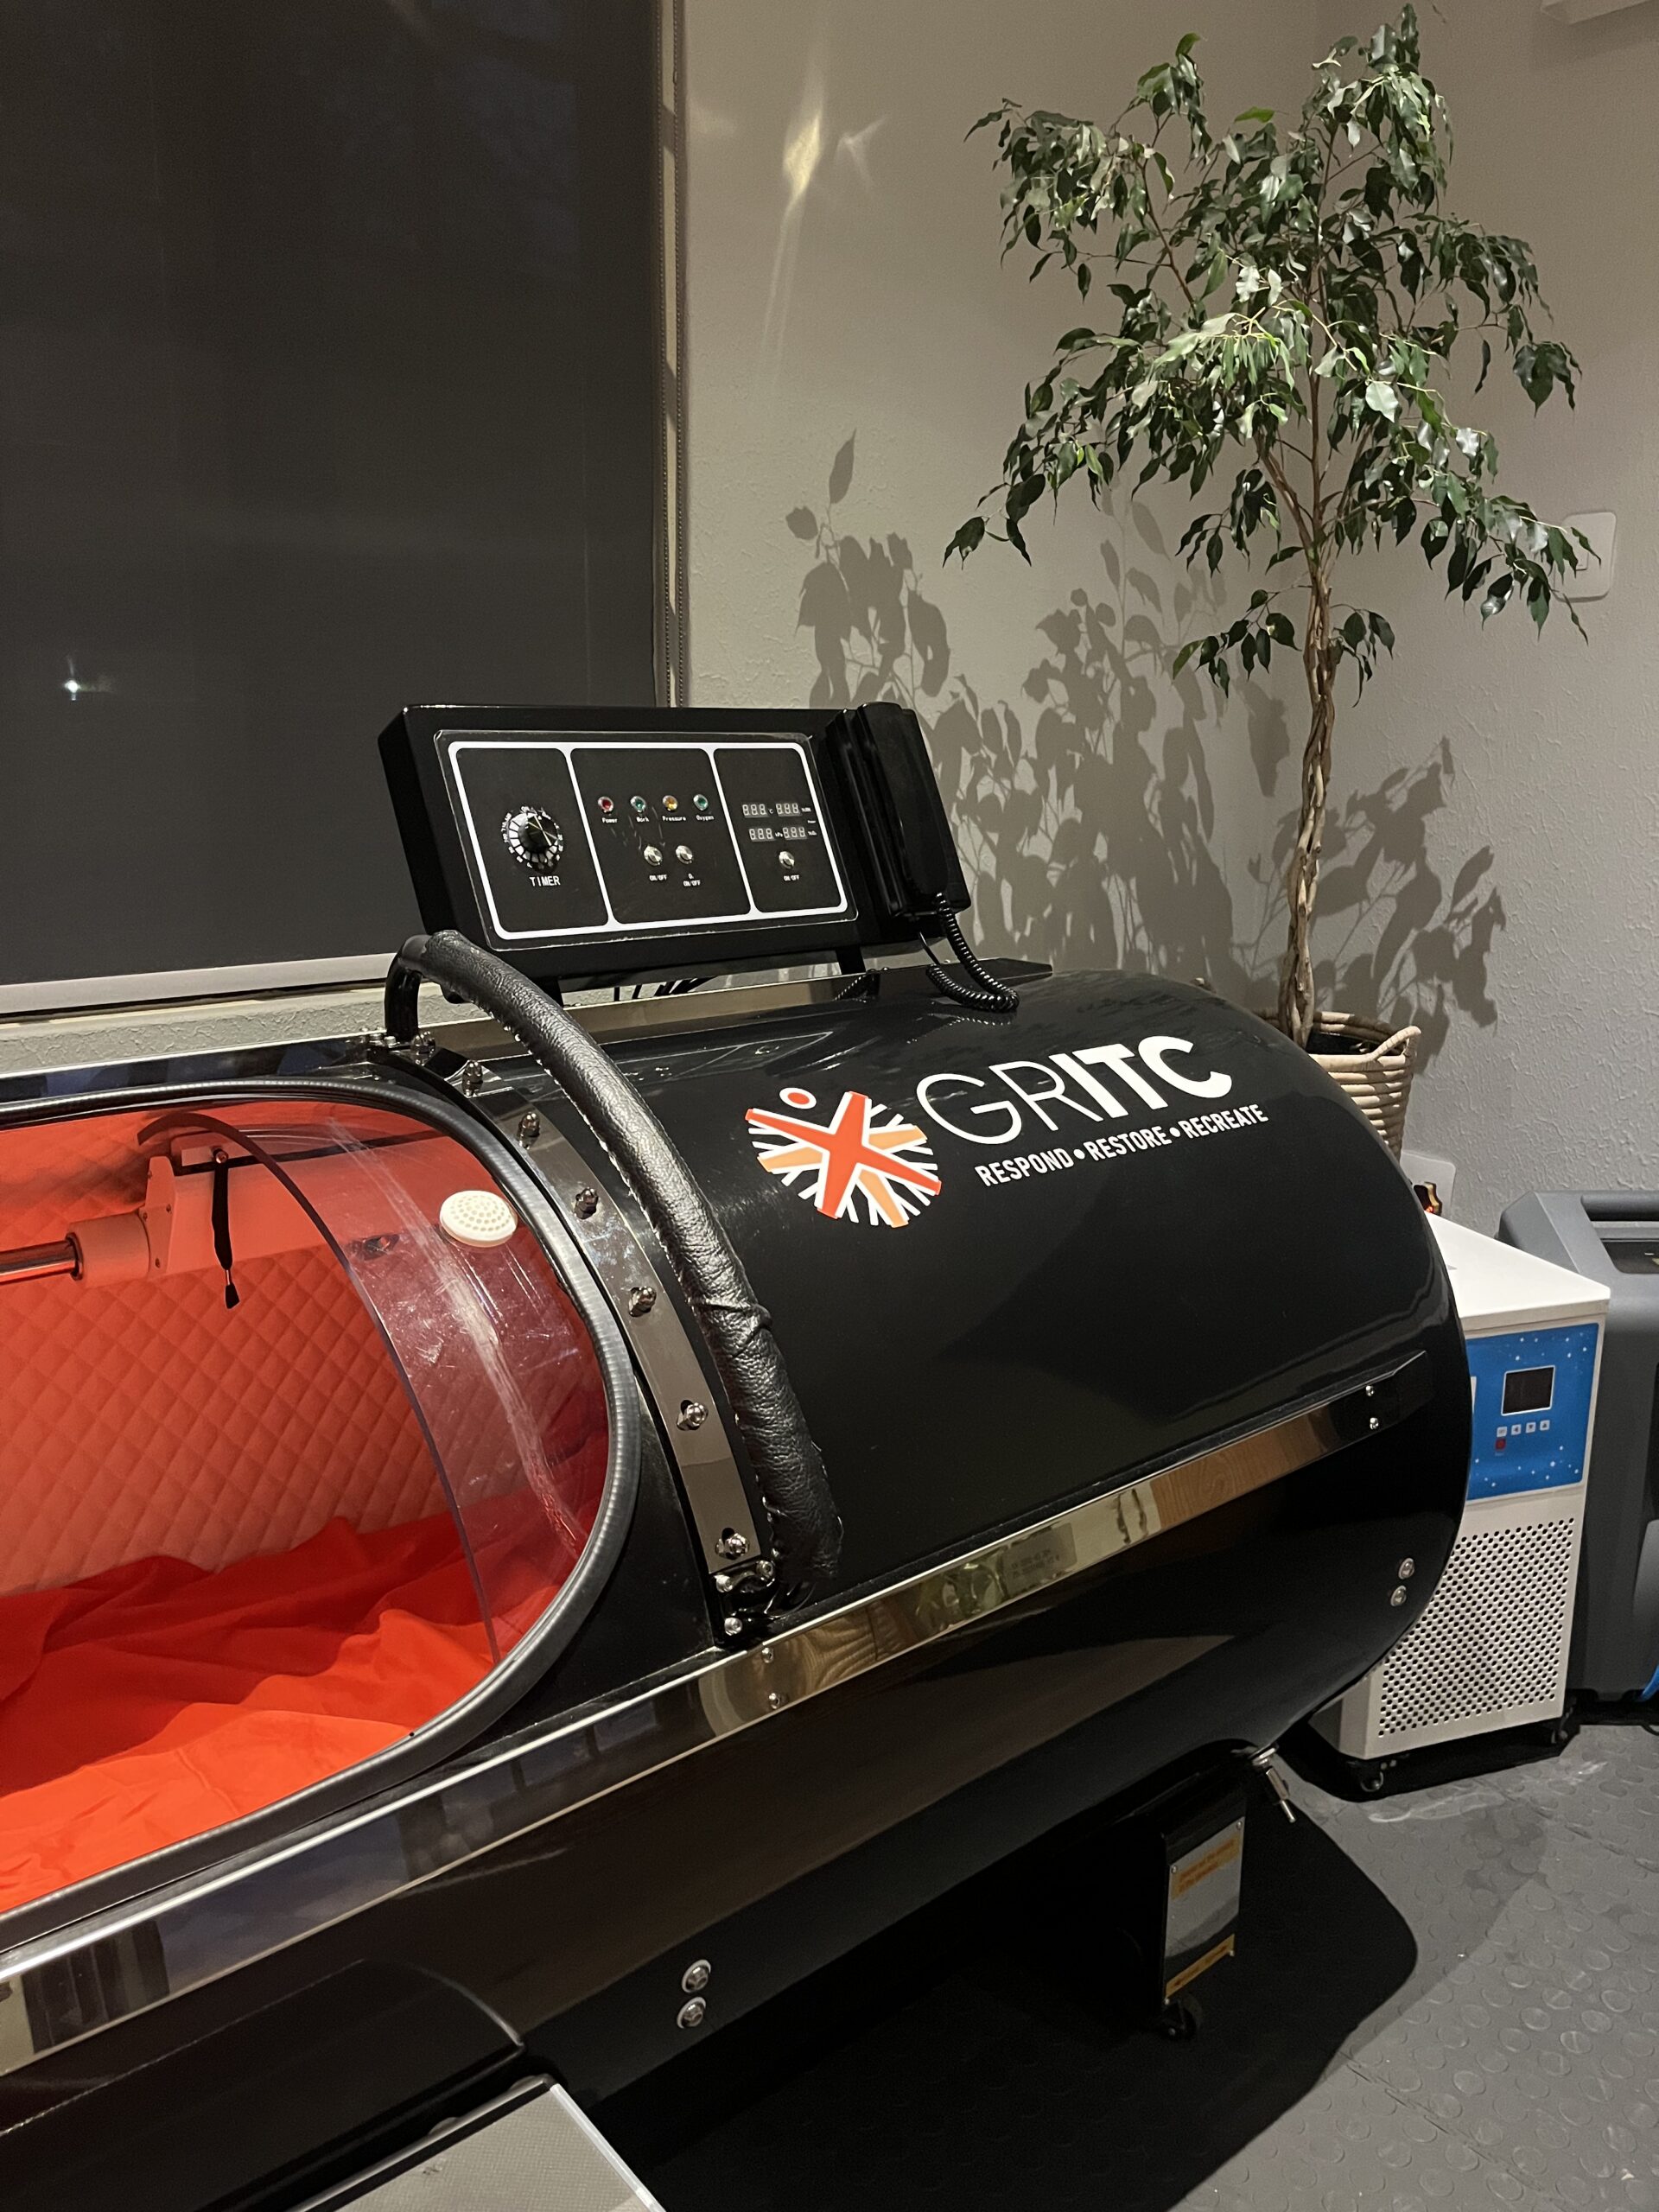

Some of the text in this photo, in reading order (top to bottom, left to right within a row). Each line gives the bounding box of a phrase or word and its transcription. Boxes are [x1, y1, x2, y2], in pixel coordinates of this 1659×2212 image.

[529, 875, 561, 887] TIMER
[916, 1035, 1233, 1145] GRITC
[974, 1103, 1269, 1186] RESPOND RESTORE RECREATE
